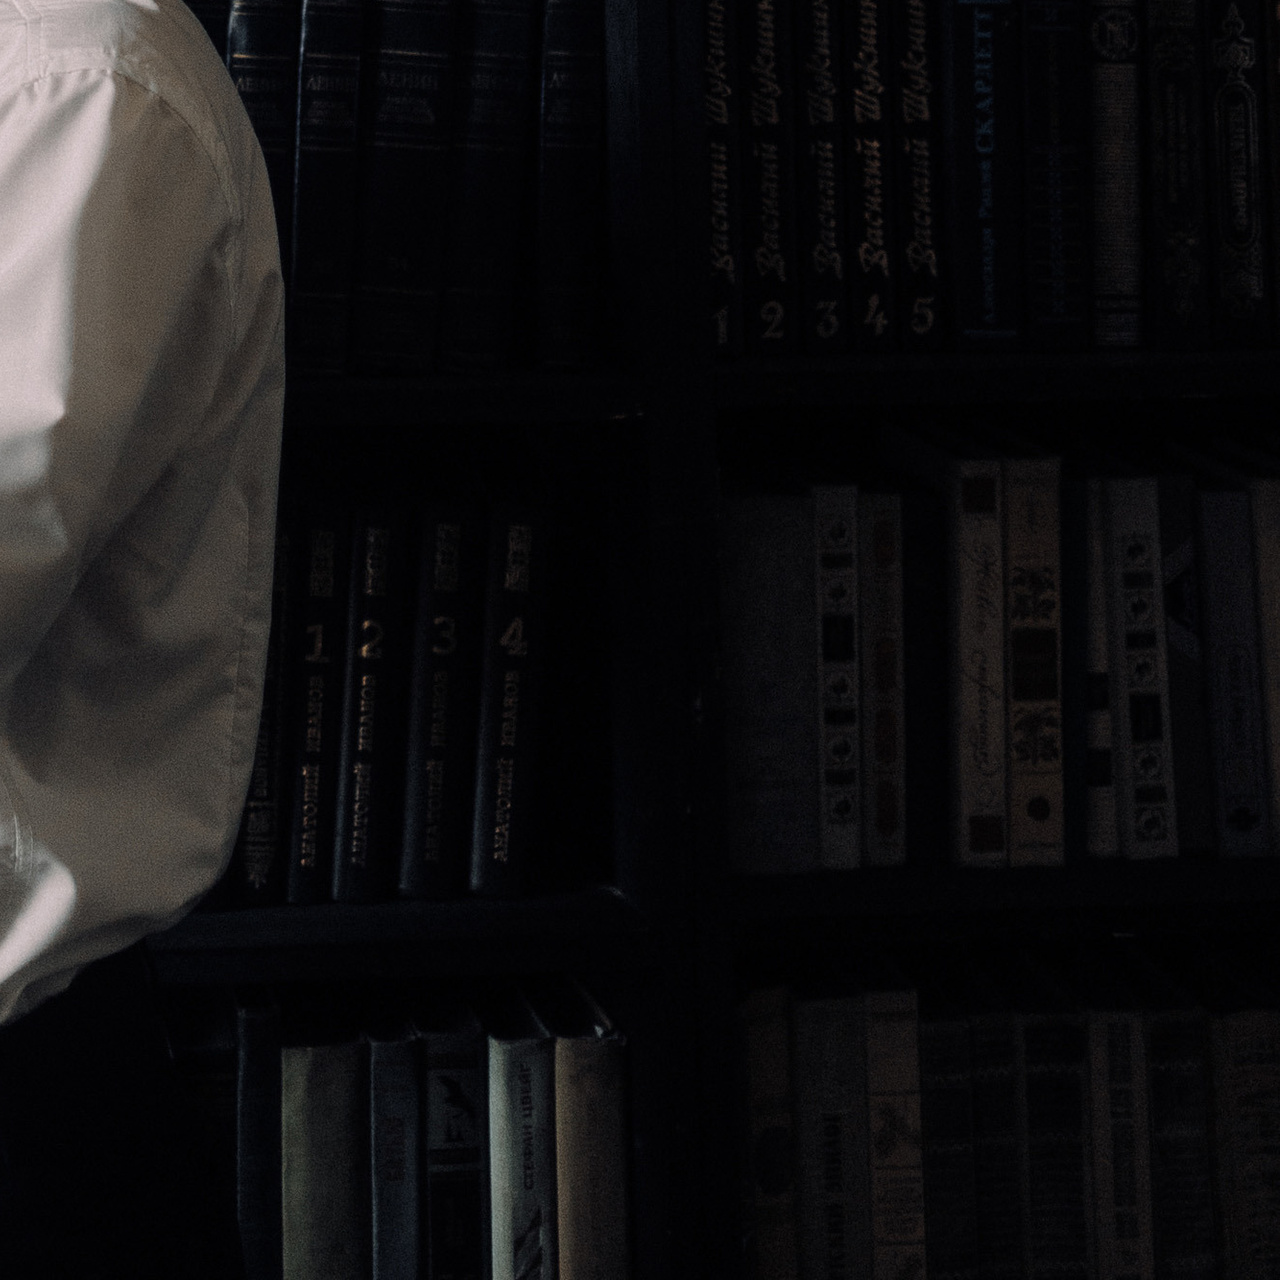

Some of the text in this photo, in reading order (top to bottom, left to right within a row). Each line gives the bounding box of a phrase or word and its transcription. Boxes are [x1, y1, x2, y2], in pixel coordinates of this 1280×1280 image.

[972, 7, 997, 155] СКАРЛЕТТ
[754, 141, 787, 284] Василий
[810, 140, 845, 280] Василий
[854, 137, 890, 277] Василий
[903, 138, 938, 277] Василий
[713, 308, 729, 344] 1
[760, 301, 785, 340] 2
[816, 301, 840, 339] 3
[862, 293, 888, 337] 4
[911, 296, 935, 335] 5
[303, 622, 331, 665] 1
[356, 618, 386, 661] 2
[430, 614, 458, 657] 3
[498, 615, 530, 658] 4
[299, 674, 325, 870] АНАТОЛИЙ ИВАНОВ
[350, 673, 377, 869] АНАТОЛИЙ ИВАНОВ
[423, 669, 449, 865] АНАТОЛИЙ ИВАНОВ
[492, 669, 521, 866] АНАТОЛИЙ ИВАНОВ
[519, 1063, 535, 1191] СТЕФАН ЦВЕЙГ
